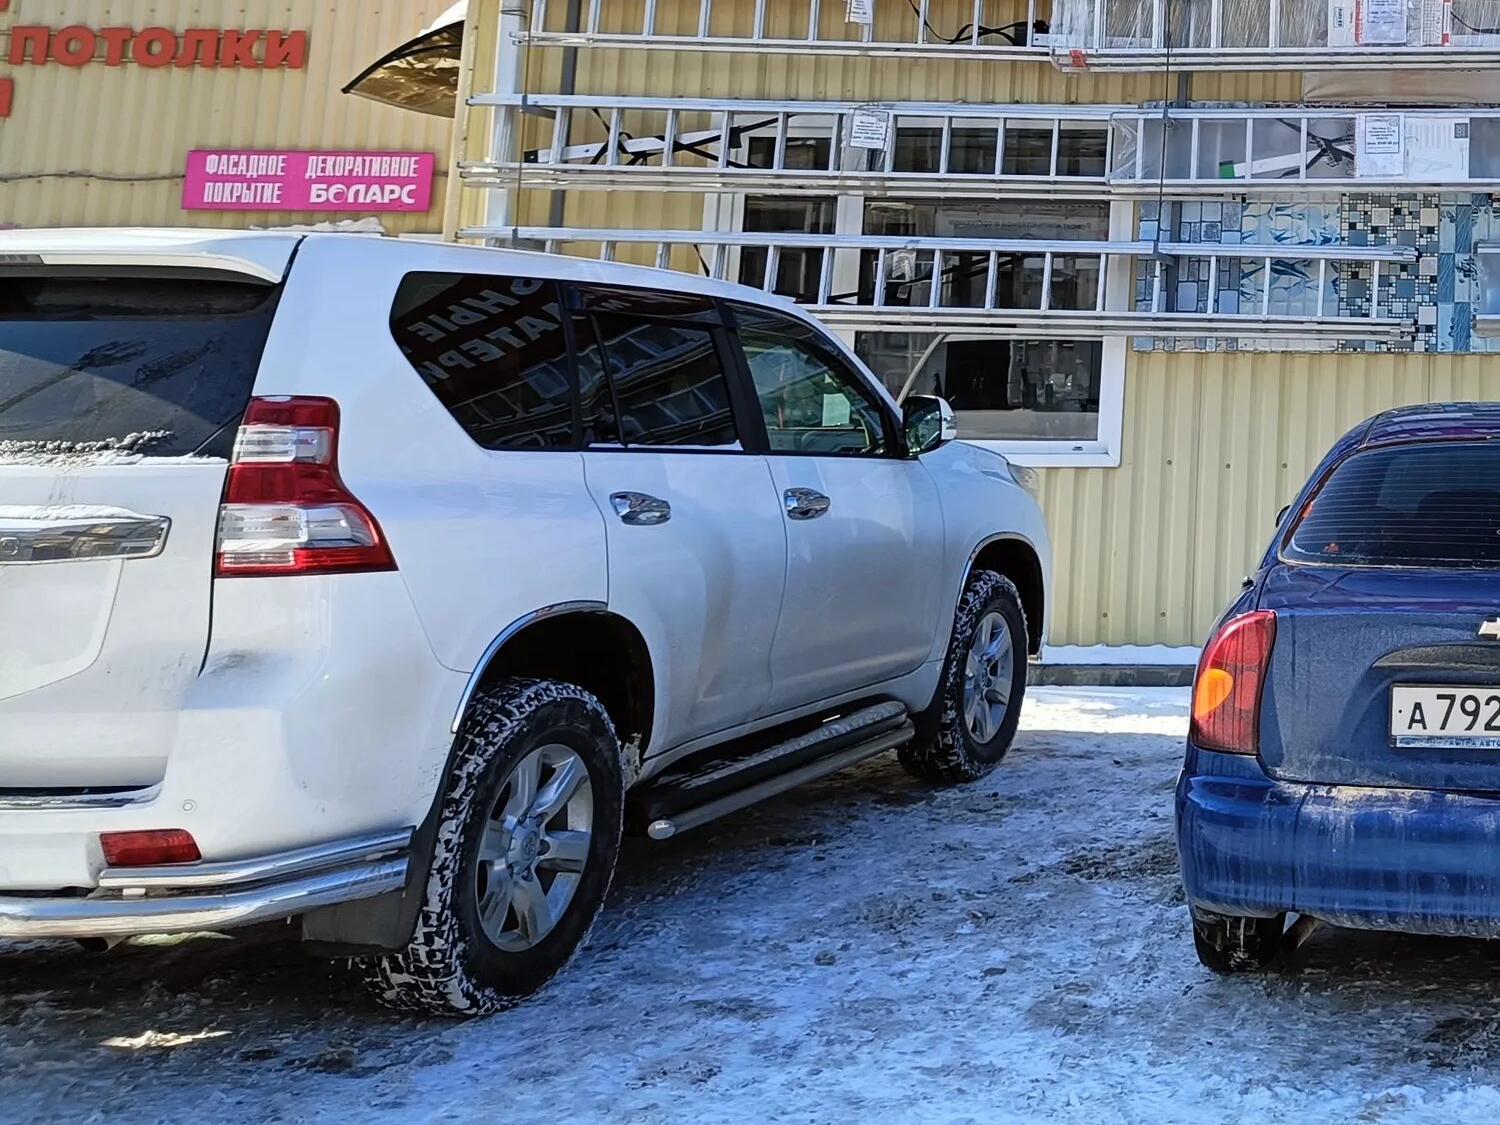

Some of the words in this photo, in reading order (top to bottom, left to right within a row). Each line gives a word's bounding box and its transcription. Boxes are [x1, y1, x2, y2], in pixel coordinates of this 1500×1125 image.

[8, 25, 307, 70] ПОТОЛКИ
[205, 154, 288, 177] ФАСАДНОЕ
[305, 156, 419, 179] ДЕКОРАТИВНОЕ
[204, 182, 283, 203] ПОКРЫТИЕ
[310, 183, 416, 204] БОЛАРС
